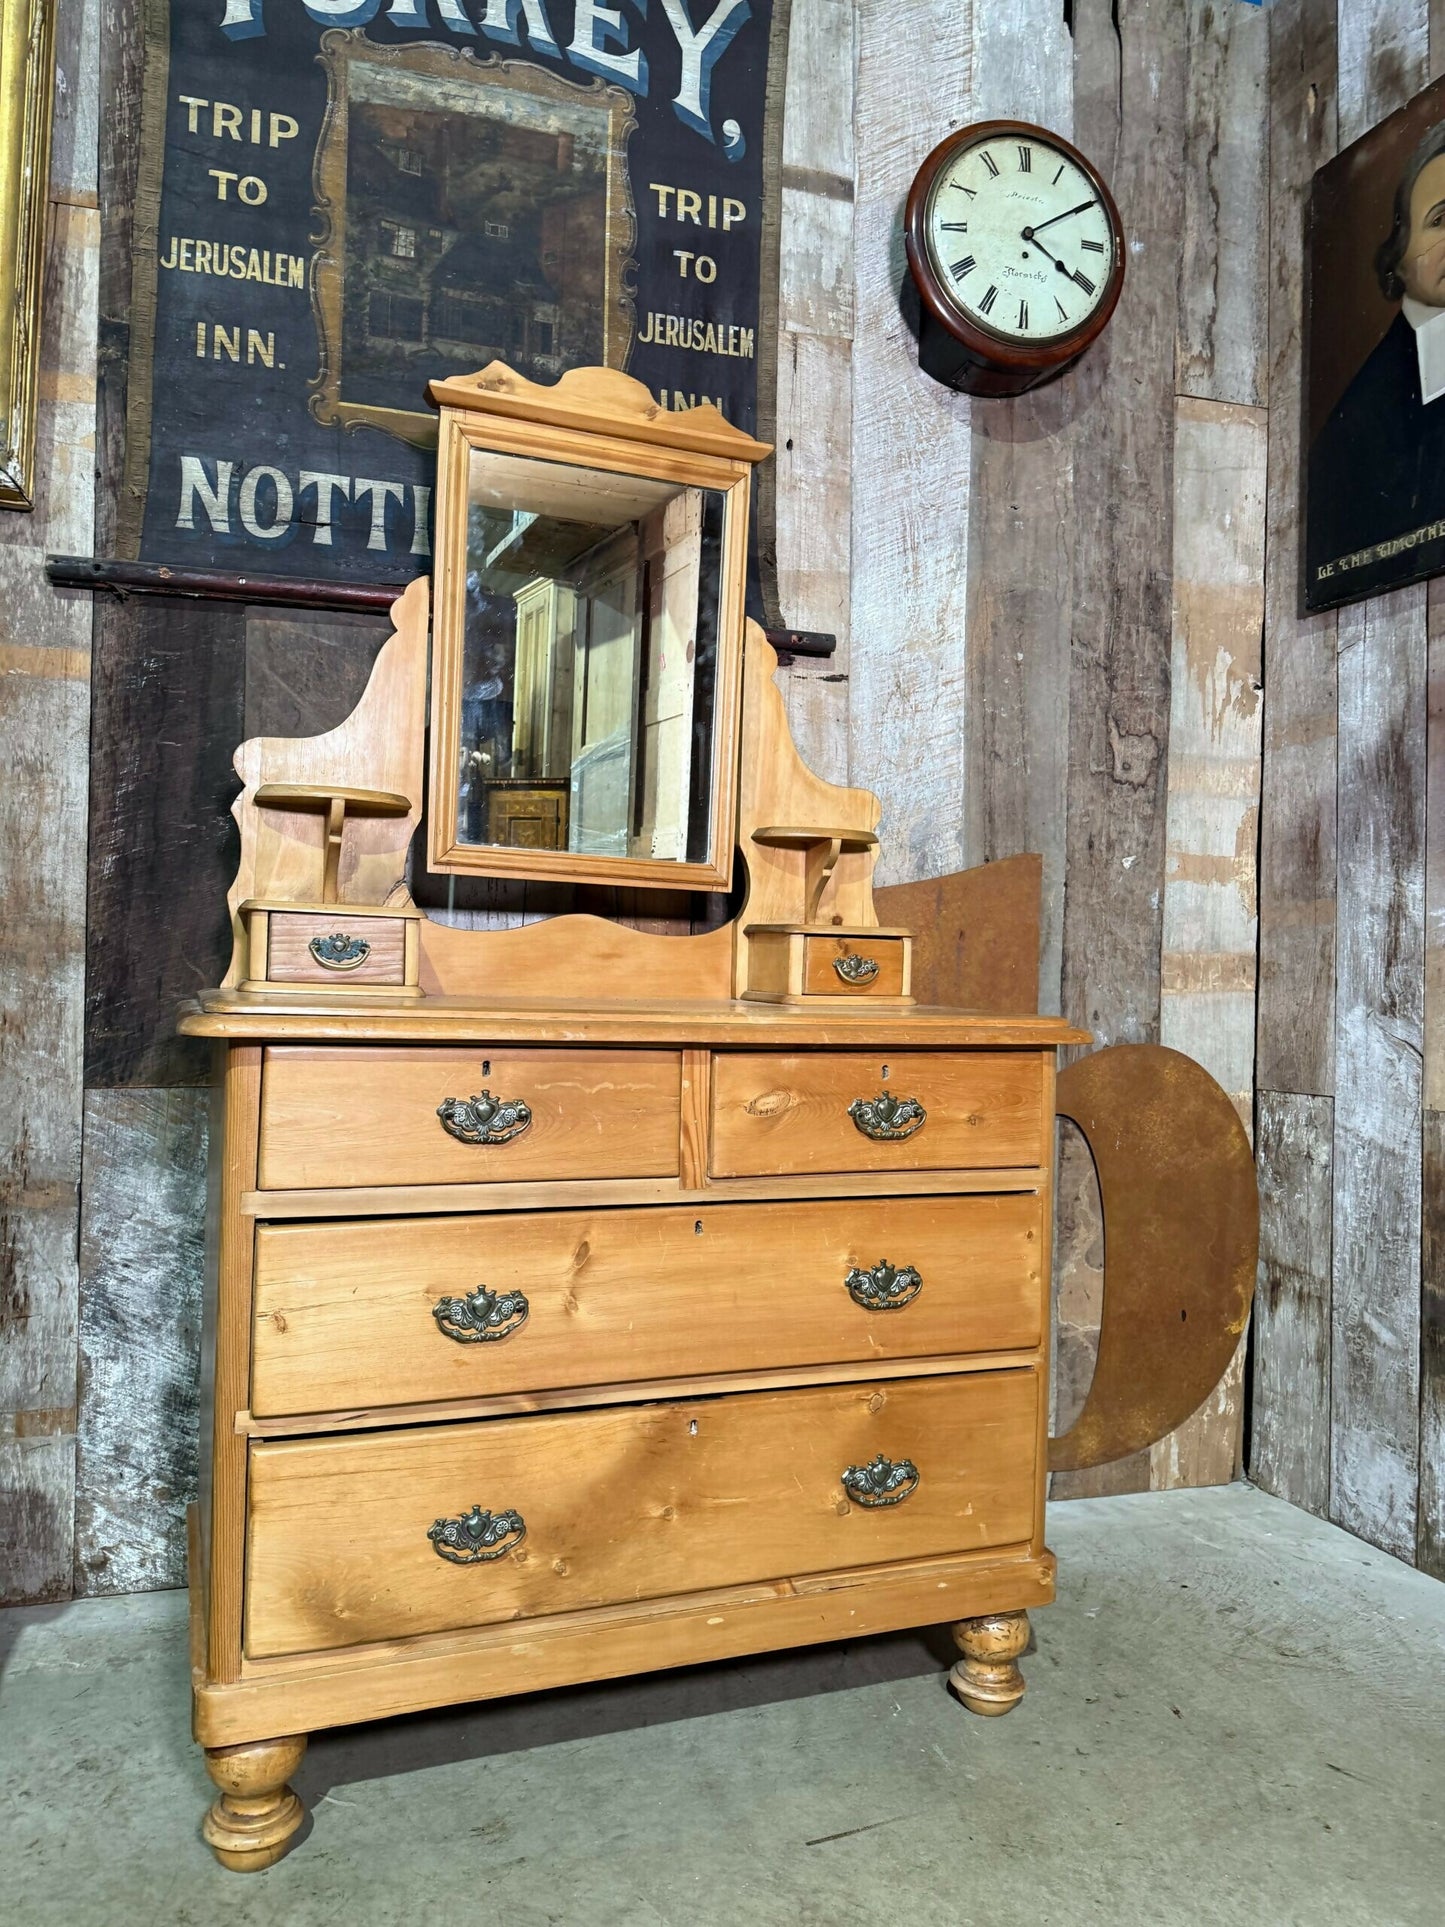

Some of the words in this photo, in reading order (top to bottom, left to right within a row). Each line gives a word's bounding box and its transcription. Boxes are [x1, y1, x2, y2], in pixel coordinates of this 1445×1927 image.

[178, 95, 299, 148] TRIP
[208, 169, 268, 206] TO
[649, 183, 747, 232] TRIP
[159, 236, 305, 290] JERUSALEM
[673, 250, 717, 284] TO
[196, 321, 287, 370] INN.
[637, 311, 754, 359] JERUSALEM
[174, 455, 432, 557] NOTTI
